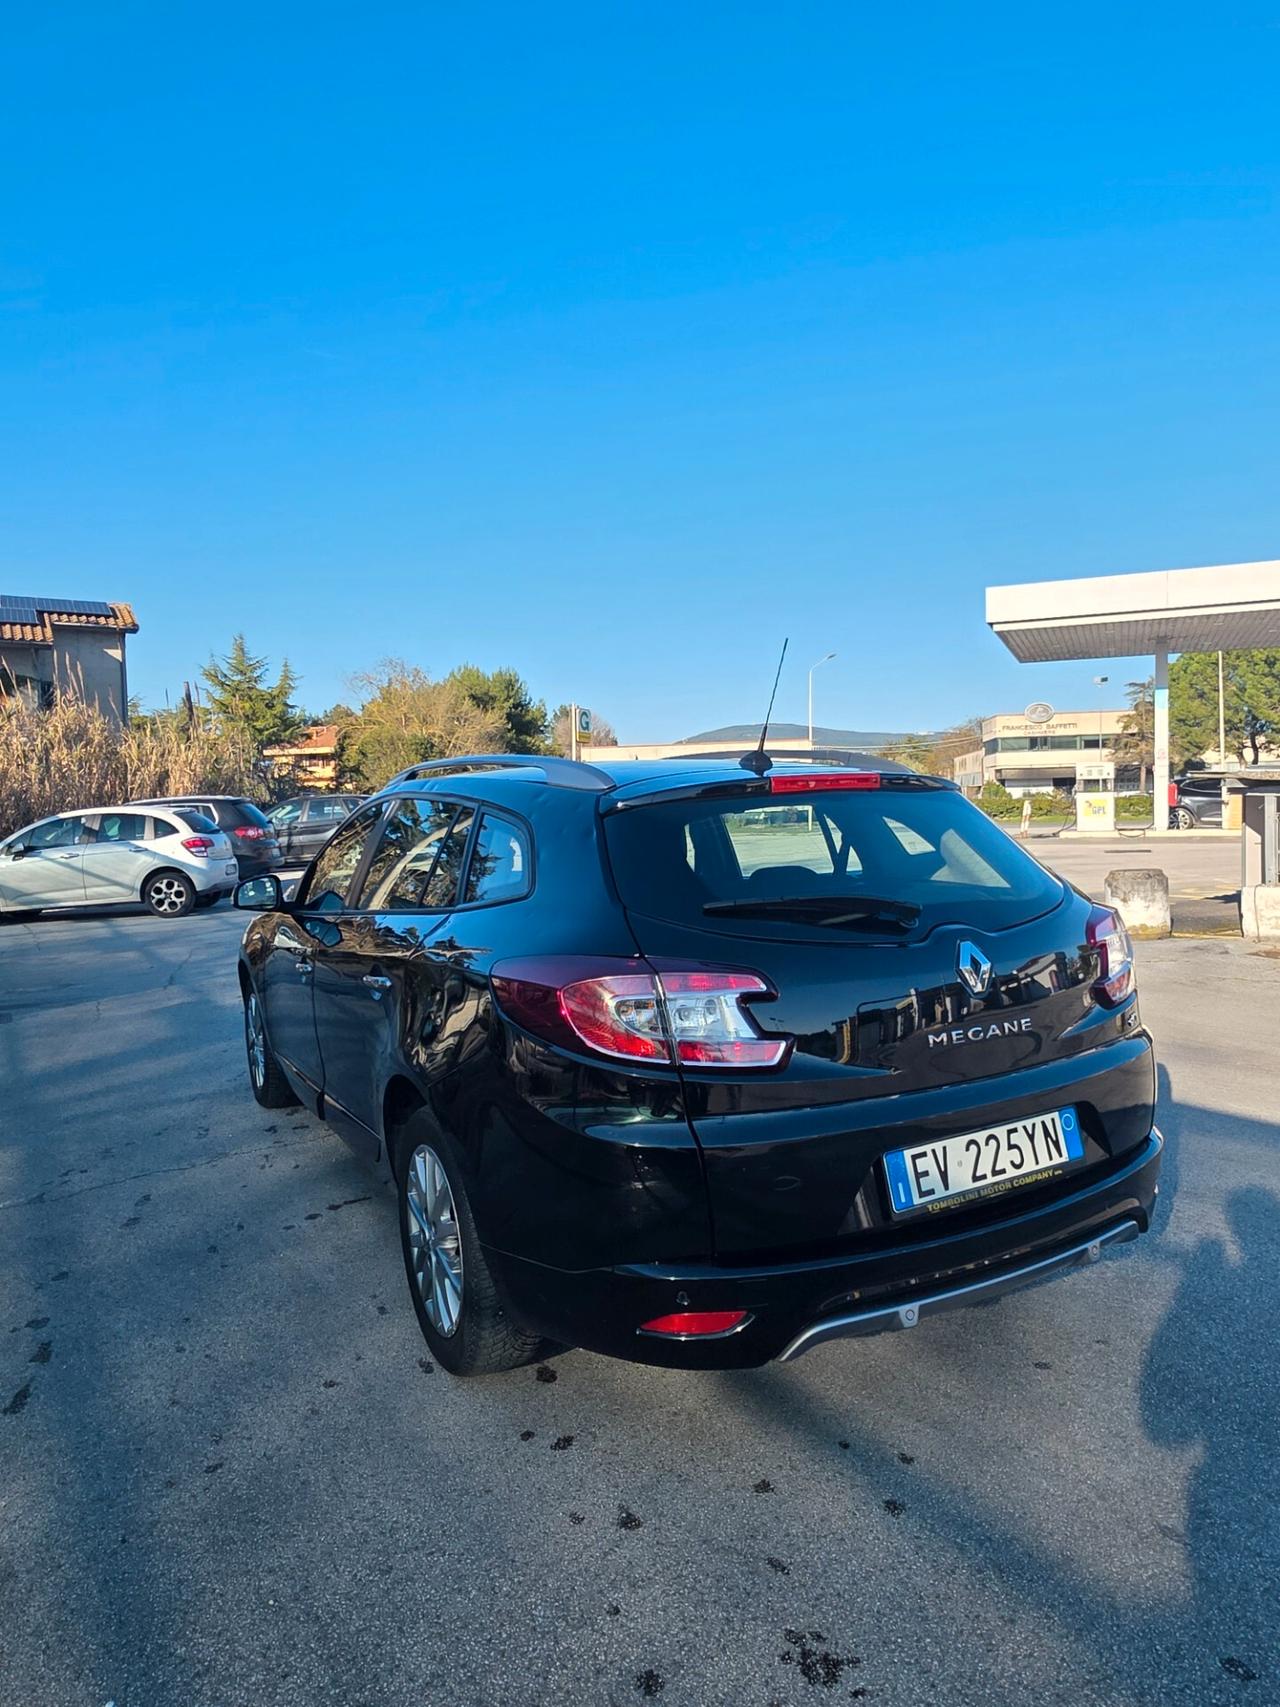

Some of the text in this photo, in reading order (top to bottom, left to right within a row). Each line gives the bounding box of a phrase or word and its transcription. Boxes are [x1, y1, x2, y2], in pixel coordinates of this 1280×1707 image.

[580, 711, 590, 732] G
[928, 1017, 1033, 1048] MEGANE
[910, 1117, 1064, 1200] EV 225YN
[927, 1168, 1054, 1212] TOMBOLINI MOTOR COMPANY
